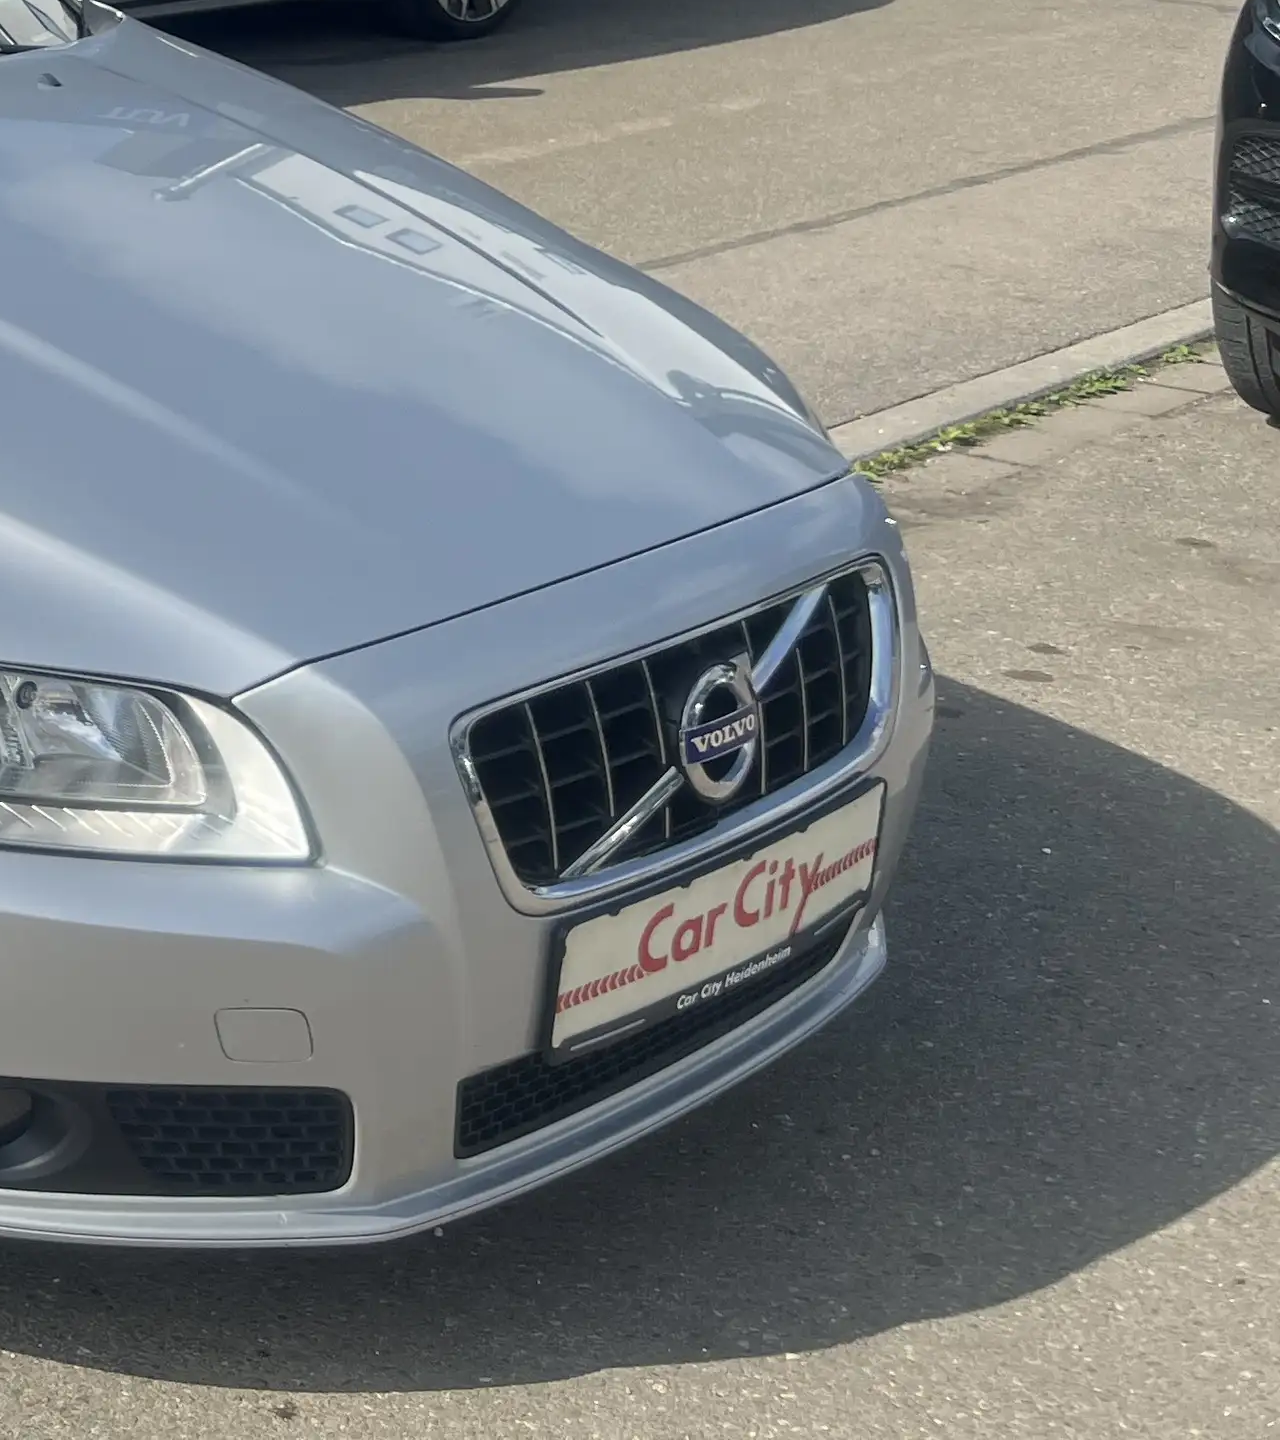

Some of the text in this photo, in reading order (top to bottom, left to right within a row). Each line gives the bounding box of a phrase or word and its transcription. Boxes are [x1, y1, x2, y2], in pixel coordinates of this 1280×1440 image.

[690, 714, 755, 753] VOLVO
[637, 856, 823, 973] Car City
[676, 946, 791, 1009] Car City Heidenheim
